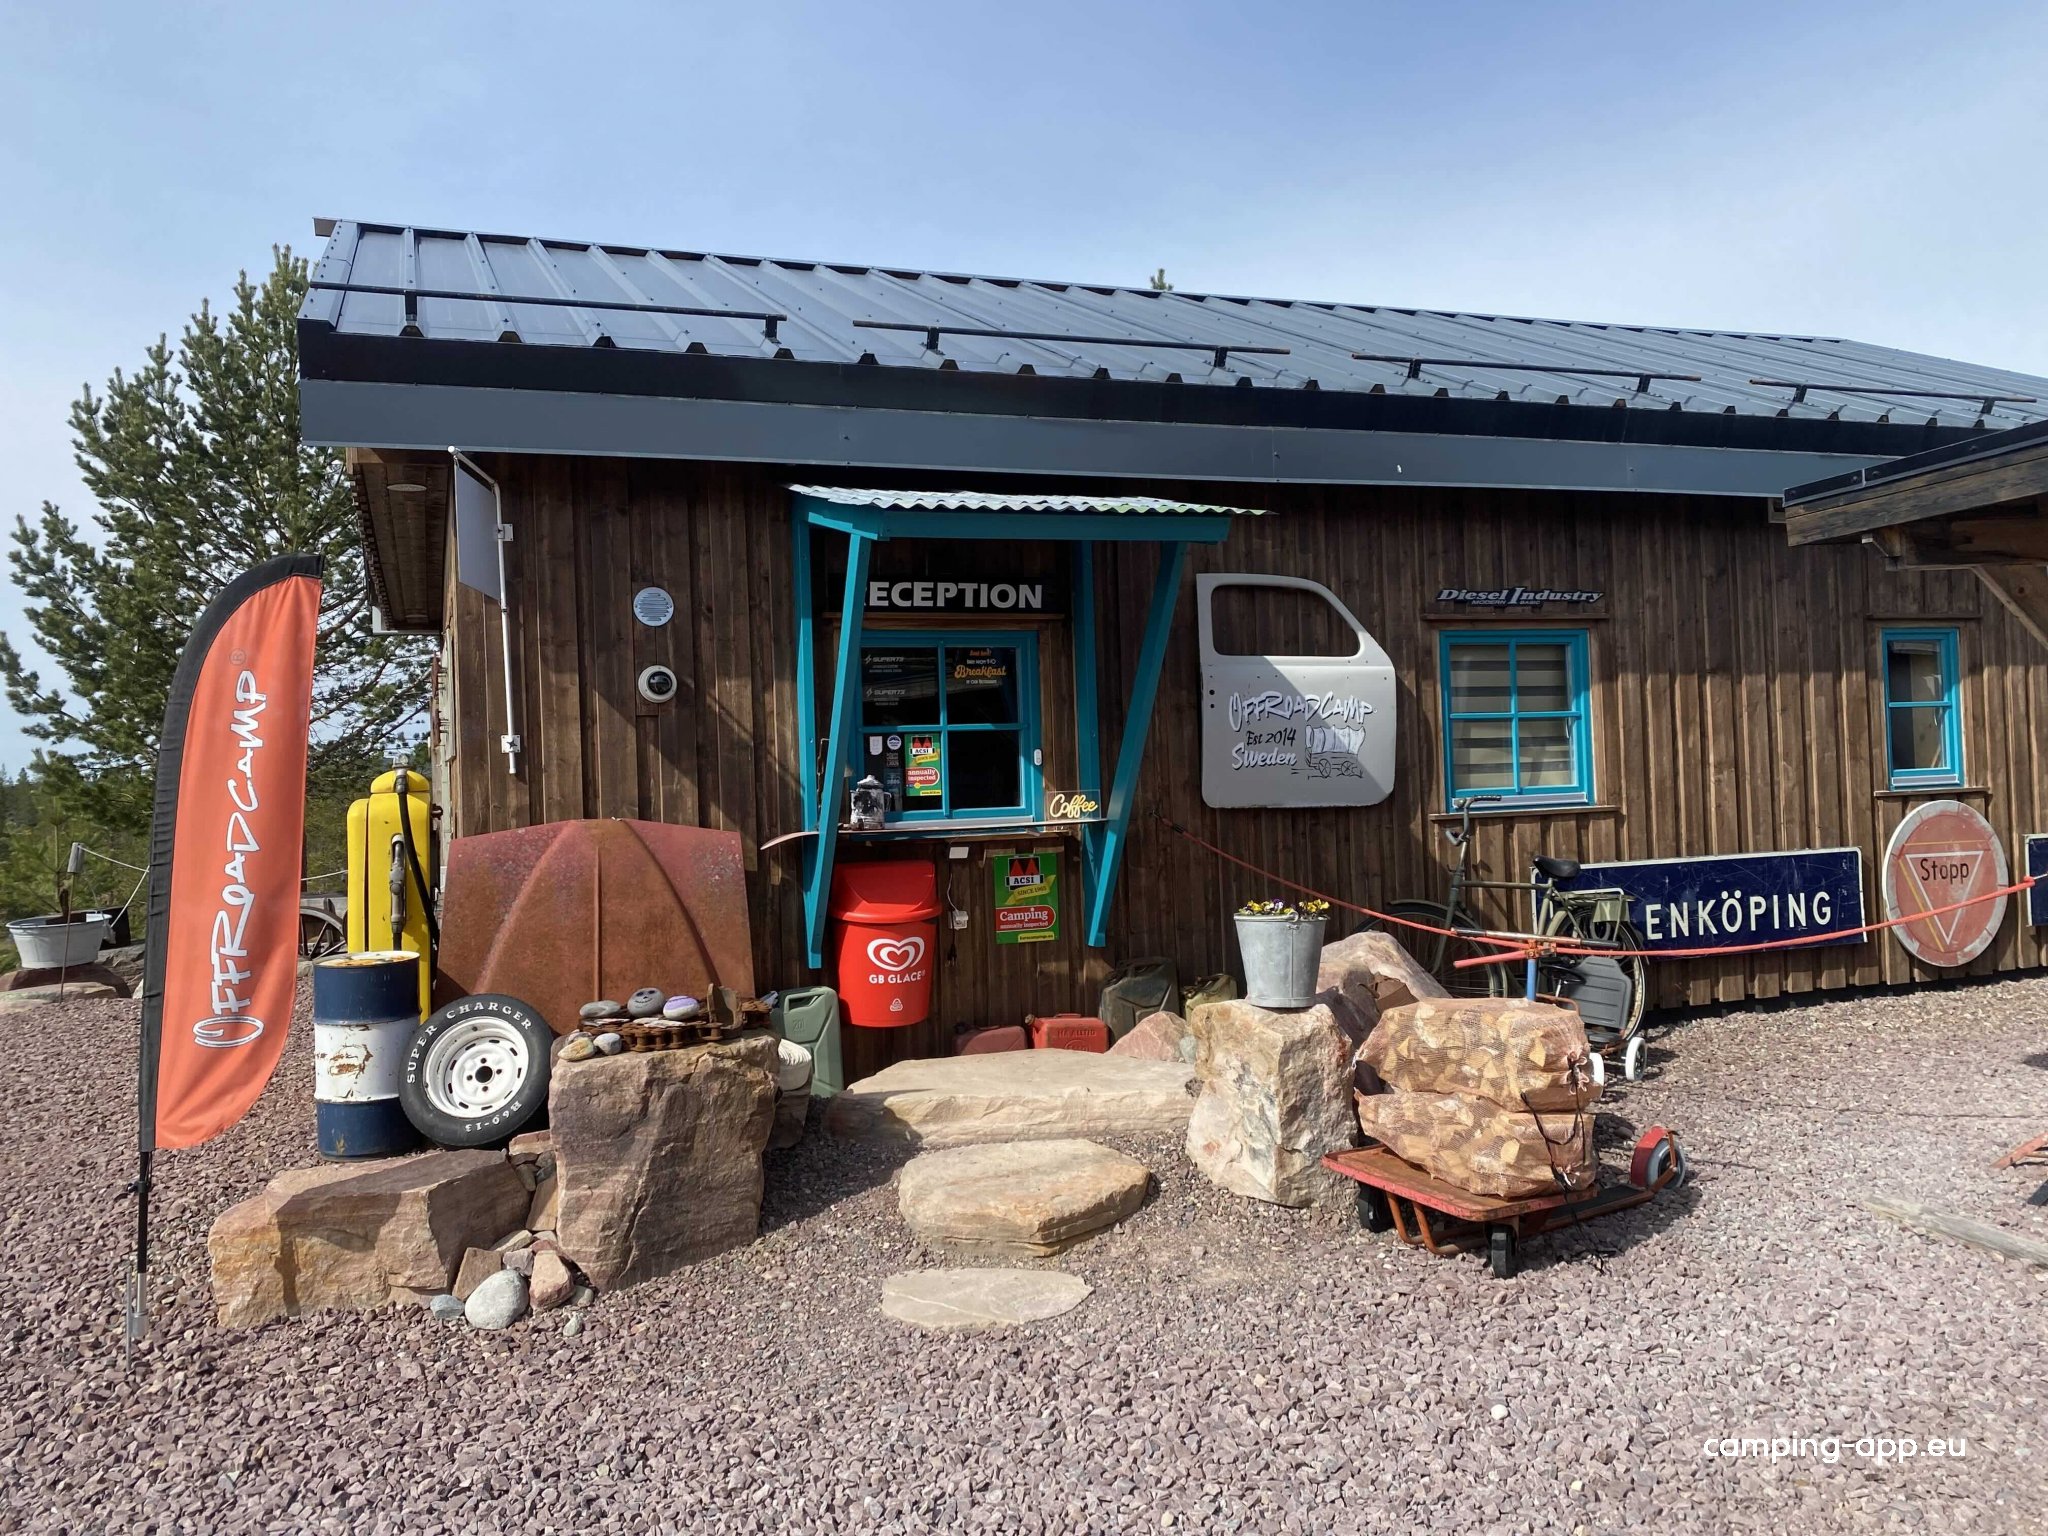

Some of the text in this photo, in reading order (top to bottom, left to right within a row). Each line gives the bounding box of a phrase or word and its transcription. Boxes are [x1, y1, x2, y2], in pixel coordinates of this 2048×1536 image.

[864, 581, 1043, 609] ECEPTION
[1437, 586, 1605, 604] Diesel Industry
[954, 664, 1007, 679] Breakfast
[1246, 727, 1297, 747] Est 2014
[1231, 741, 1298, 771] Sweden
[907, 768, 936, 776] annually
[1050, 793, 1099, 818] Coffee
[1013, 876, 1034, 885] ACSI
[1920, 858, 1970, 886] Stopp
[1017, 888, 1035, 896] SINCE
[999, 907, 1048, 922] Camping
[1645, 889, 1832, 941] ENKÖPING
[868, 974, 885, 984] GB
[407, 1001, 533, 1084] SUPER CHARGER
